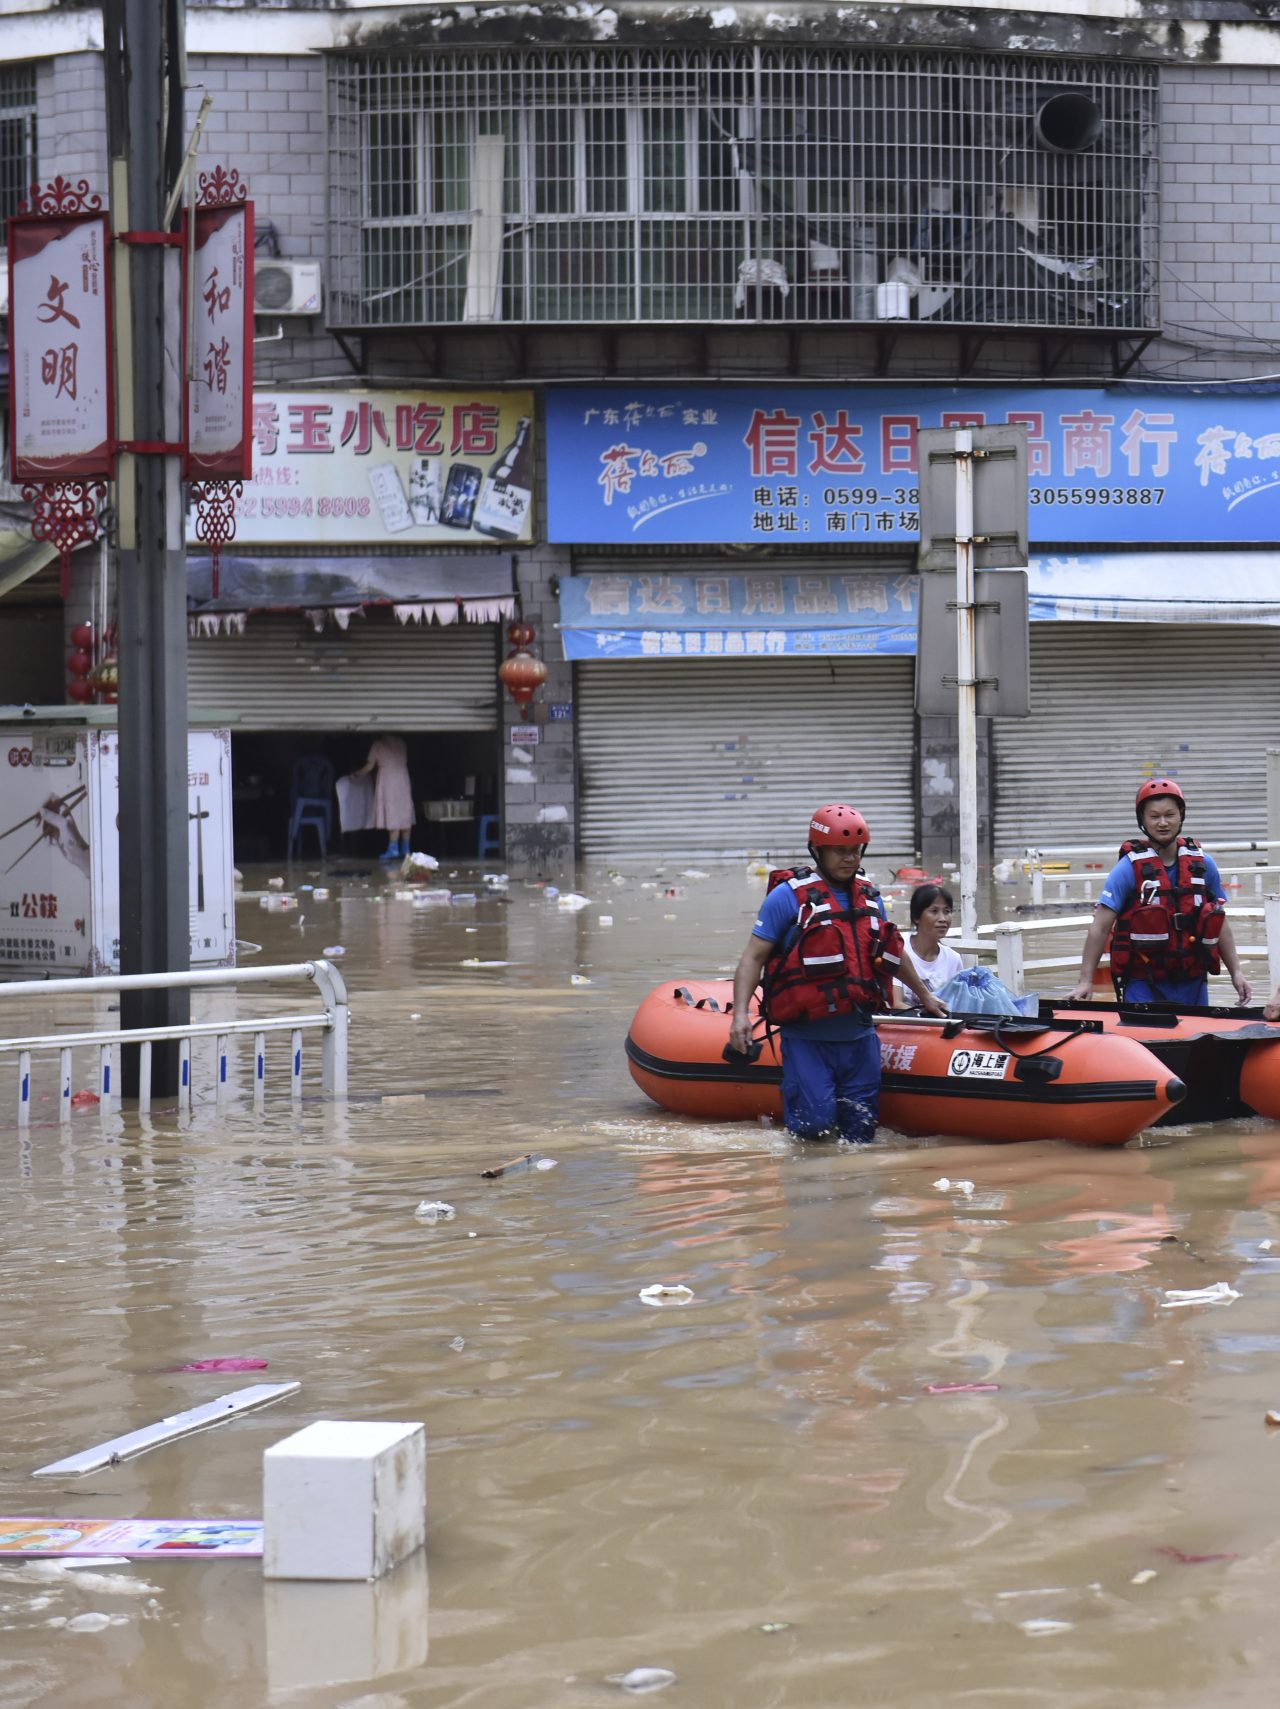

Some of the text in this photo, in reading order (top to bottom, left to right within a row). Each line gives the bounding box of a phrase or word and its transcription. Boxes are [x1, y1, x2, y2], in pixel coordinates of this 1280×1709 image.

[36, 275, 81, 402] 文明
[202, 267, 232, 396] 和谐
[744, 409, 1178, 478] 信达日品商行
[317, 495, 372, 518] 8608
[825, 511, 919, 532] 南门市场
